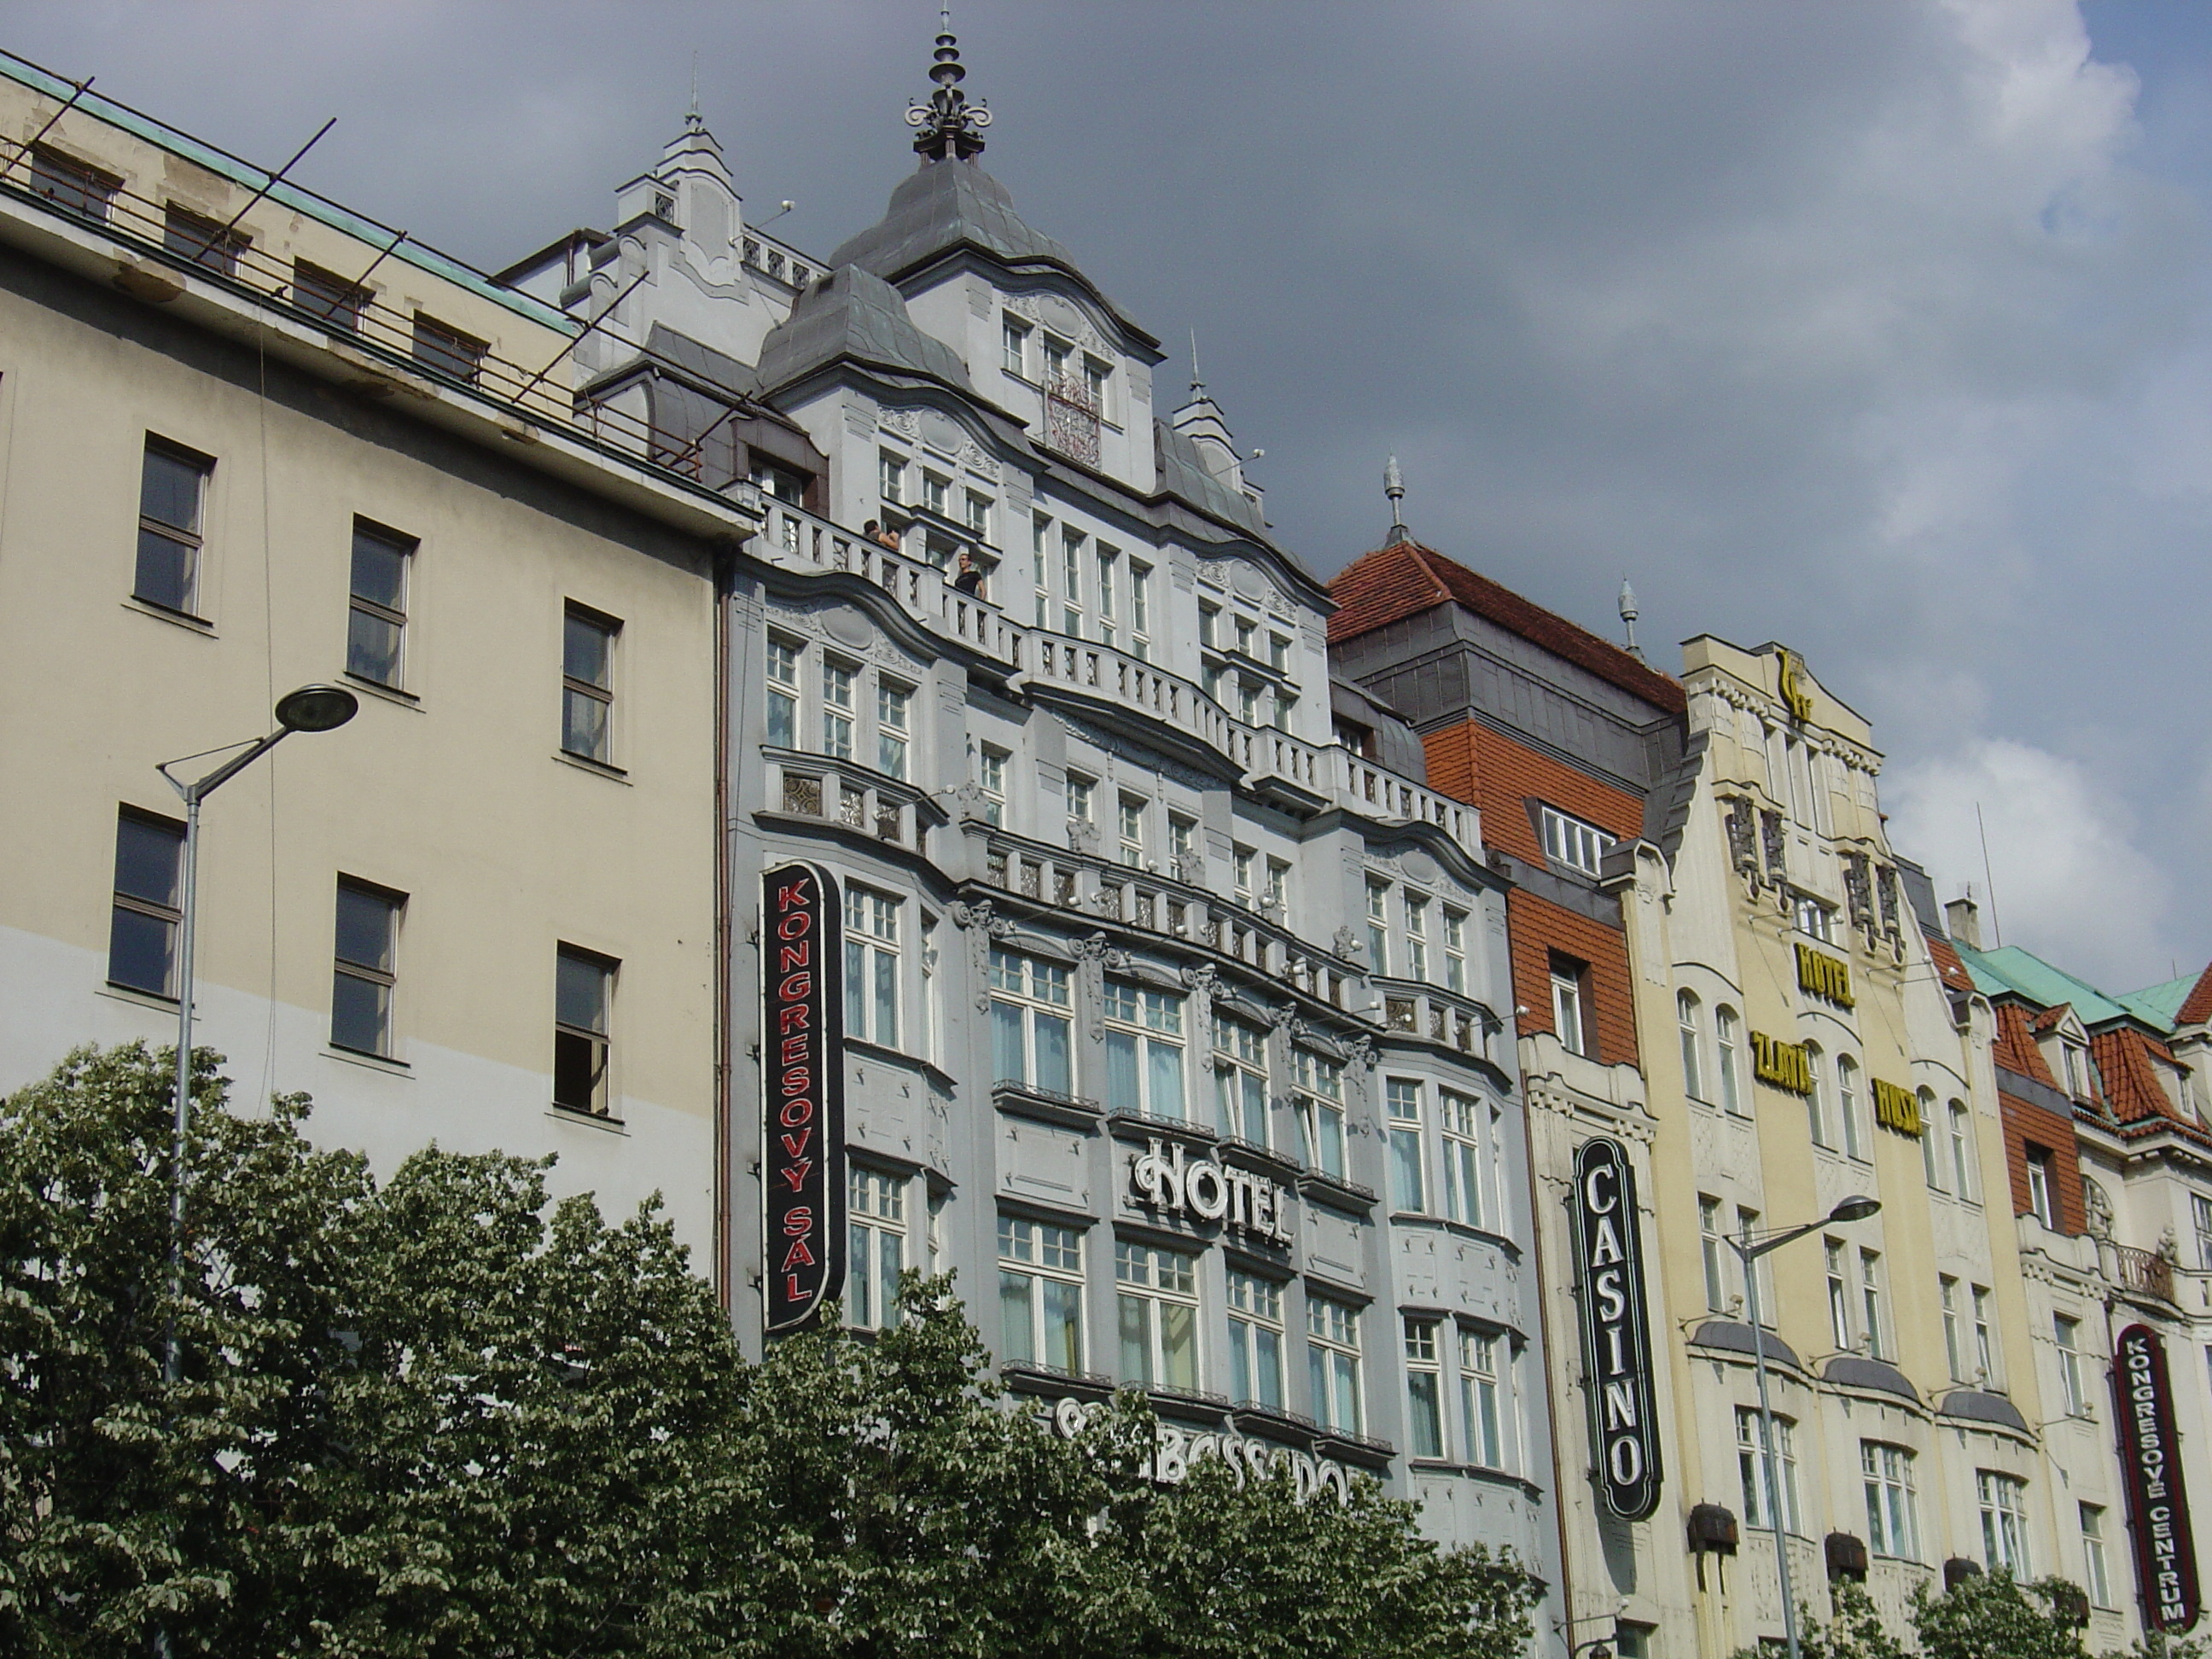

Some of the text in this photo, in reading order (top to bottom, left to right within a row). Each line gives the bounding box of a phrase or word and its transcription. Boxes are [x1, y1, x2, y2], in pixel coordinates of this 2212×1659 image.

[1795, 942, 1855, 1009] HOTEL
[777, 877, 814, 1302] KONGRESOVÝ SÁL
[1871, 1078, 1923, 1137] HUSA
[1133, 1137, 1295, 1246] HOTEL
[1586, 1164, 1642, 1486] CASINO
[2150, 1506, 2186, 1621] CENTRUM
